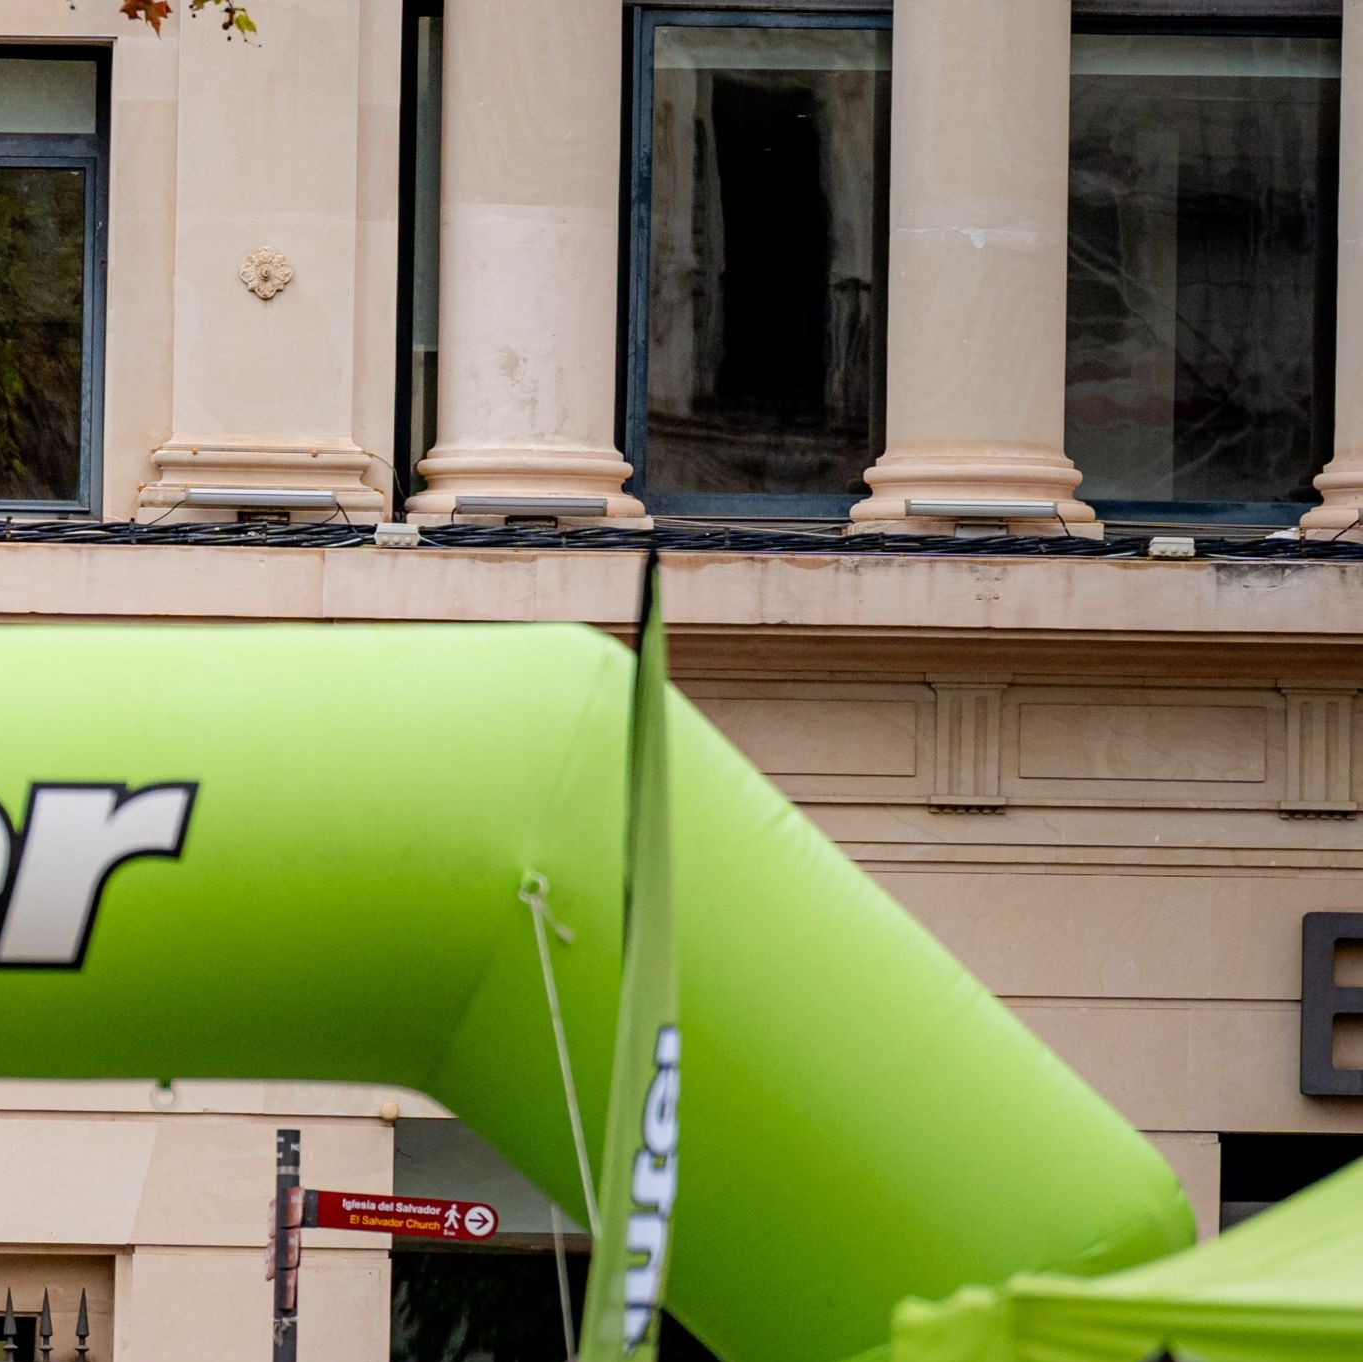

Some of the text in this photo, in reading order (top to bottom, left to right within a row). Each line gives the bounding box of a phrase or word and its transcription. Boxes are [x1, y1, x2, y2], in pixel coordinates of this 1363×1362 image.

[342, 1198, 441, 1215] Iglesia del Salvador
[349, 1214, 441, 1231] El Salvador Church
